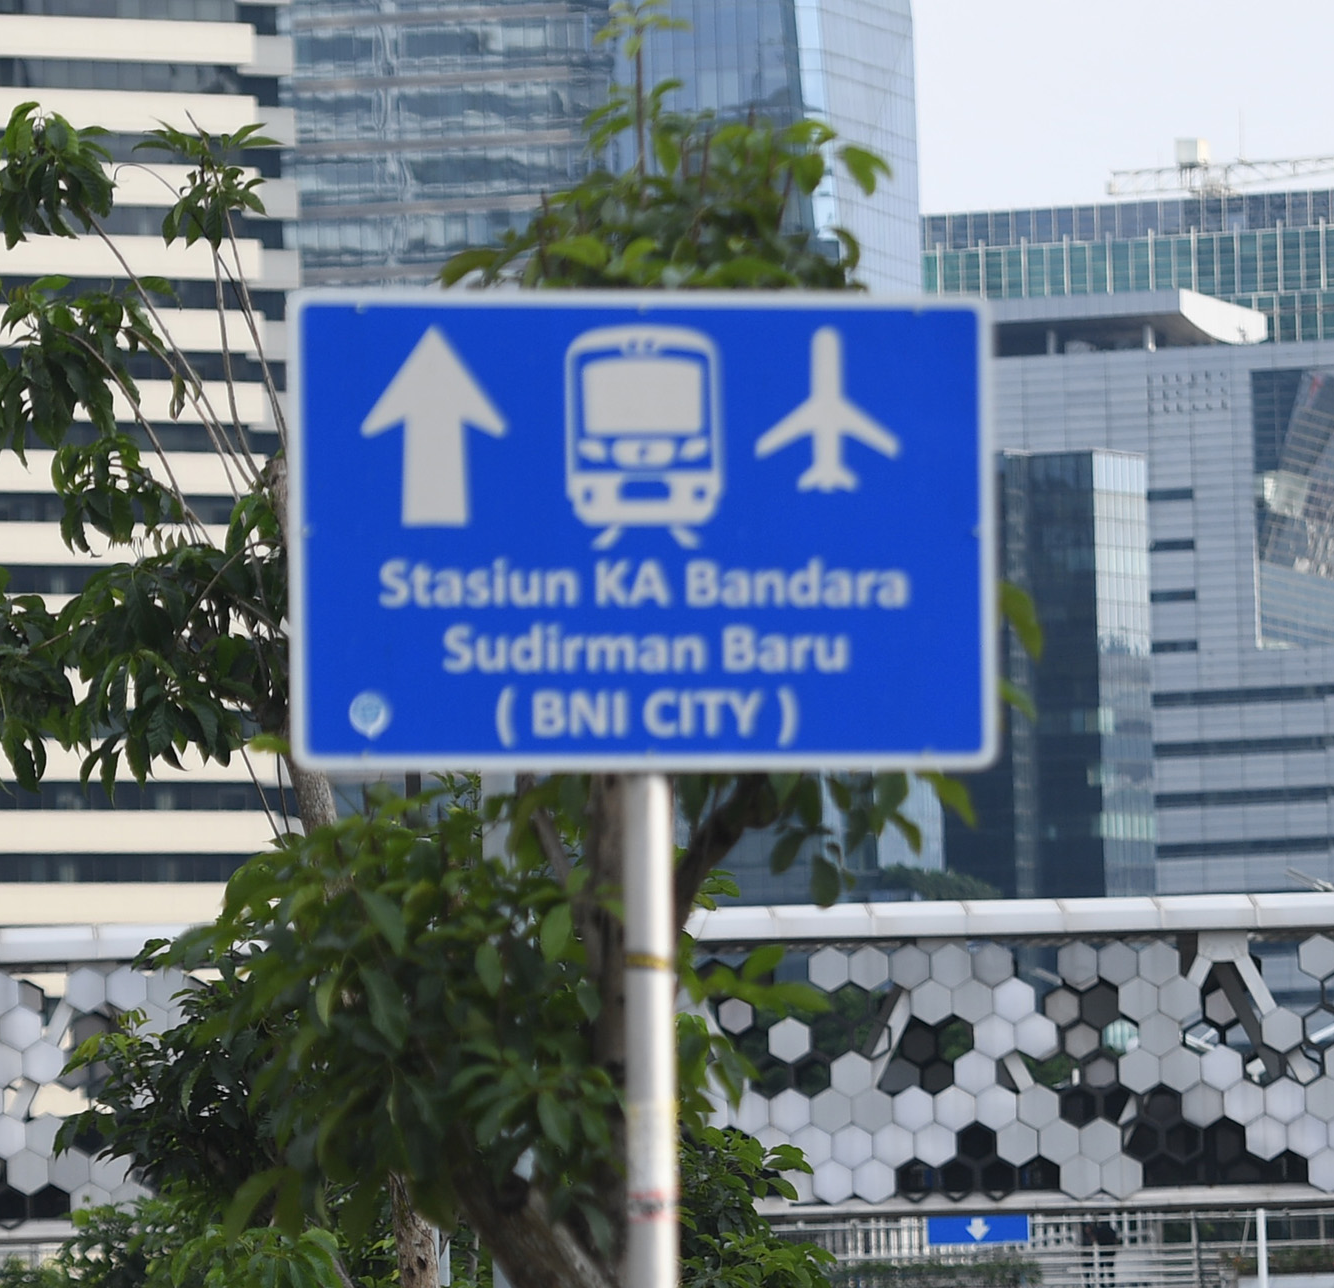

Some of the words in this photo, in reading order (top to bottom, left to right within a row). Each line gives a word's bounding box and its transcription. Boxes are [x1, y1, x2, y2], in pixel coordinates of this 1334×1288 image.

[378, 558, 579, 607] Stasiun
[595, 560, 670, 606] KA
[686, 558, 910, 608] Bandara
[442, 624, 706, 674] Sudirman
[722, 625, 850, 673] Baru
[532, 690, 627, 737] BNI
[643, 690, 762, 737] CITY
